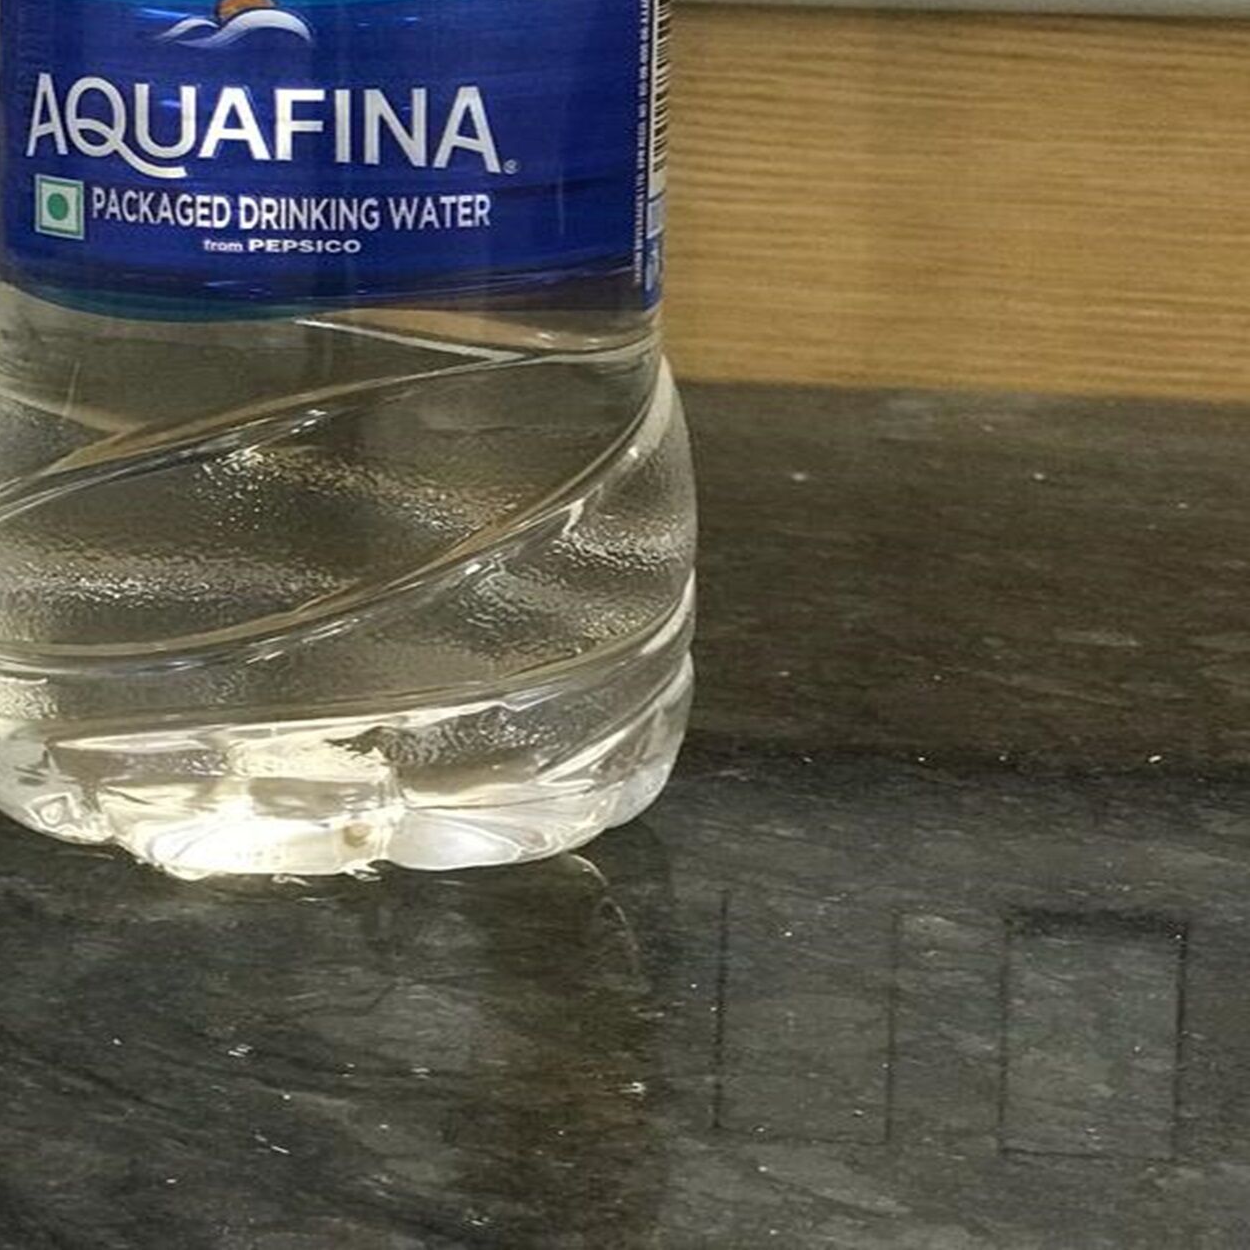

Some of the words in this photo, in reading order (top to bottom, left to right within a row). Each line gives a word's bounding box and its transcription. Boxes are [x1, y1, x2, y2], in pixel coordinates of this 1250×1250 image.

[91, 186, 230, 231] PACKAGED
[238, 194, 381, 231] DRINKING
[388, 193, 492, 230] WATER
[203, 238, 244, 253] from
[248, 238, 362, 254] PEPSICO
